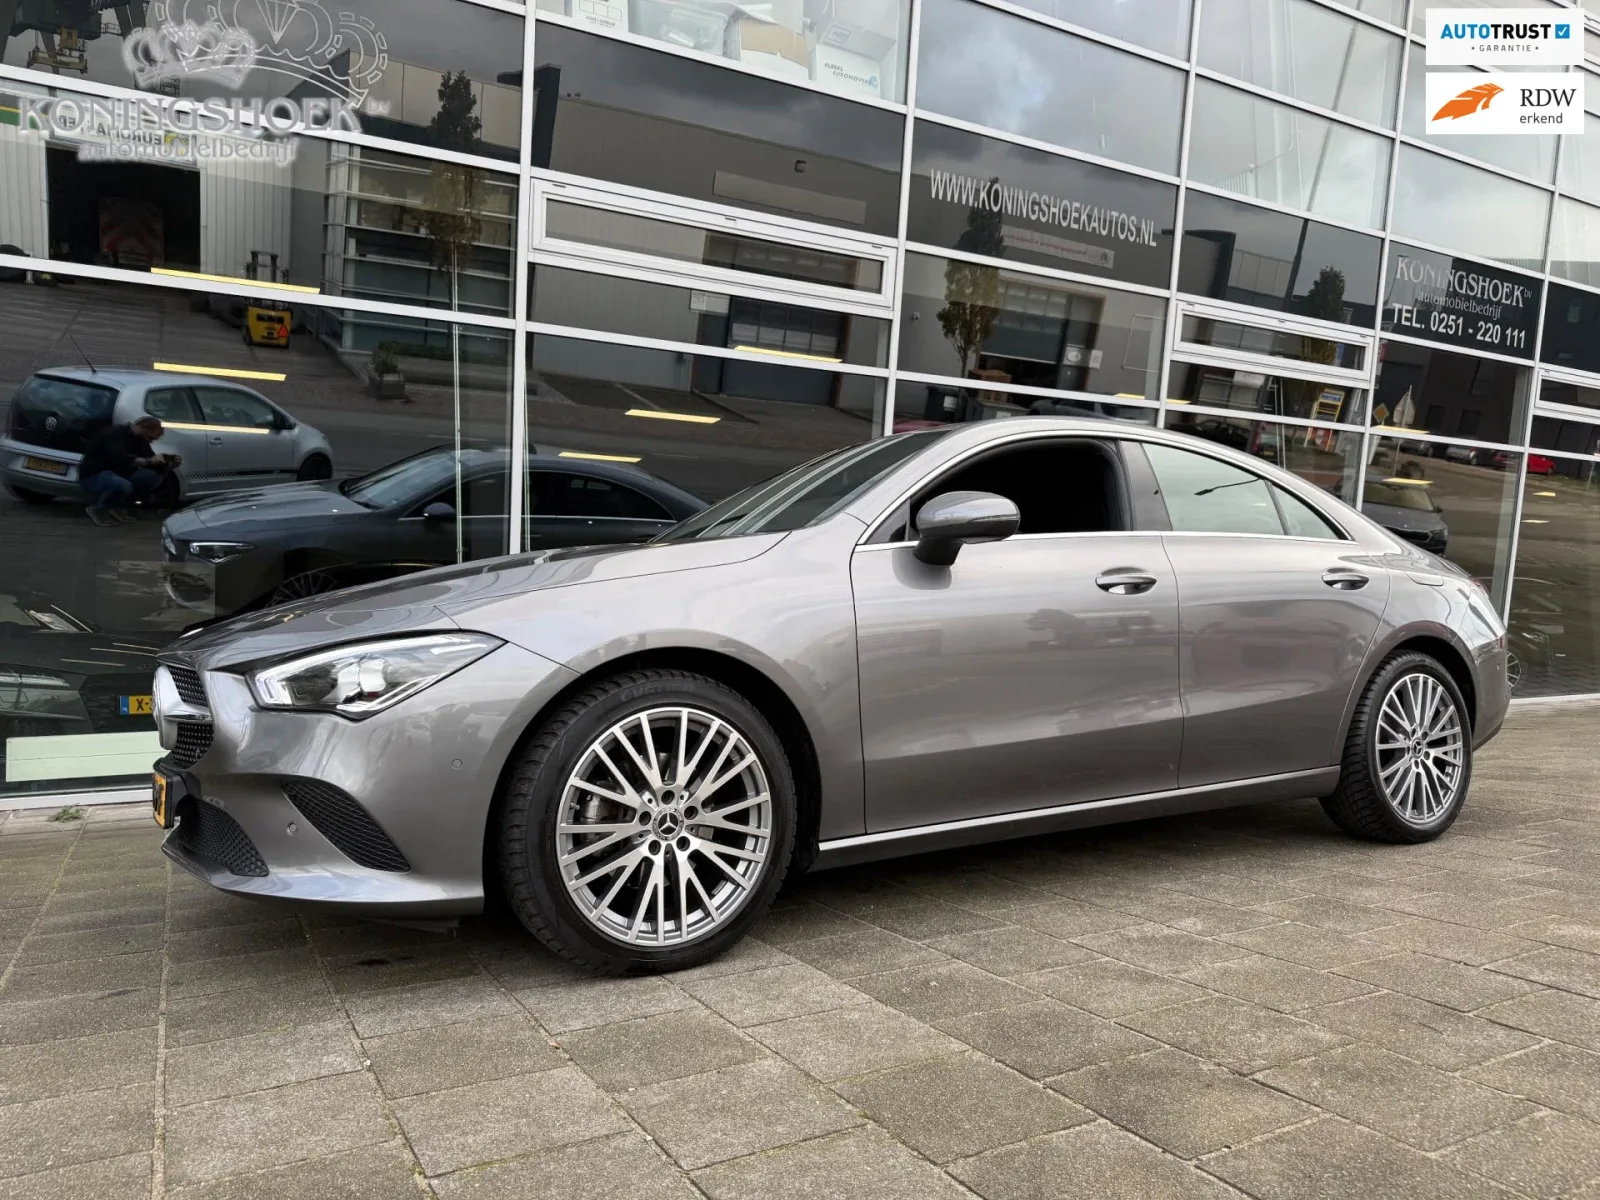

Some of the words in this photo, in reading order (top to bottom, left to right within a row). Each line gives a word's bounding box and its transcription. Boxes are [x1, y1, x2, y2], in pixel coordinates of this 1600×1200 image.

[930, 169, 1157, 247] WWW.KONINGSHOEKAUTOS.NL
[1396, 256, 1524, 308] KONINGSHOEK
[1523, 287, 1533, 298] bv
[1417, 291, 1502, 321] automobielbedrijf
[1392, 303, 1425, 329] TEL.
[1430, 311, 1464, 336] 0251
[1476, 320, 1501, 344] 220
[1505, 327, 1526, 349] 111
